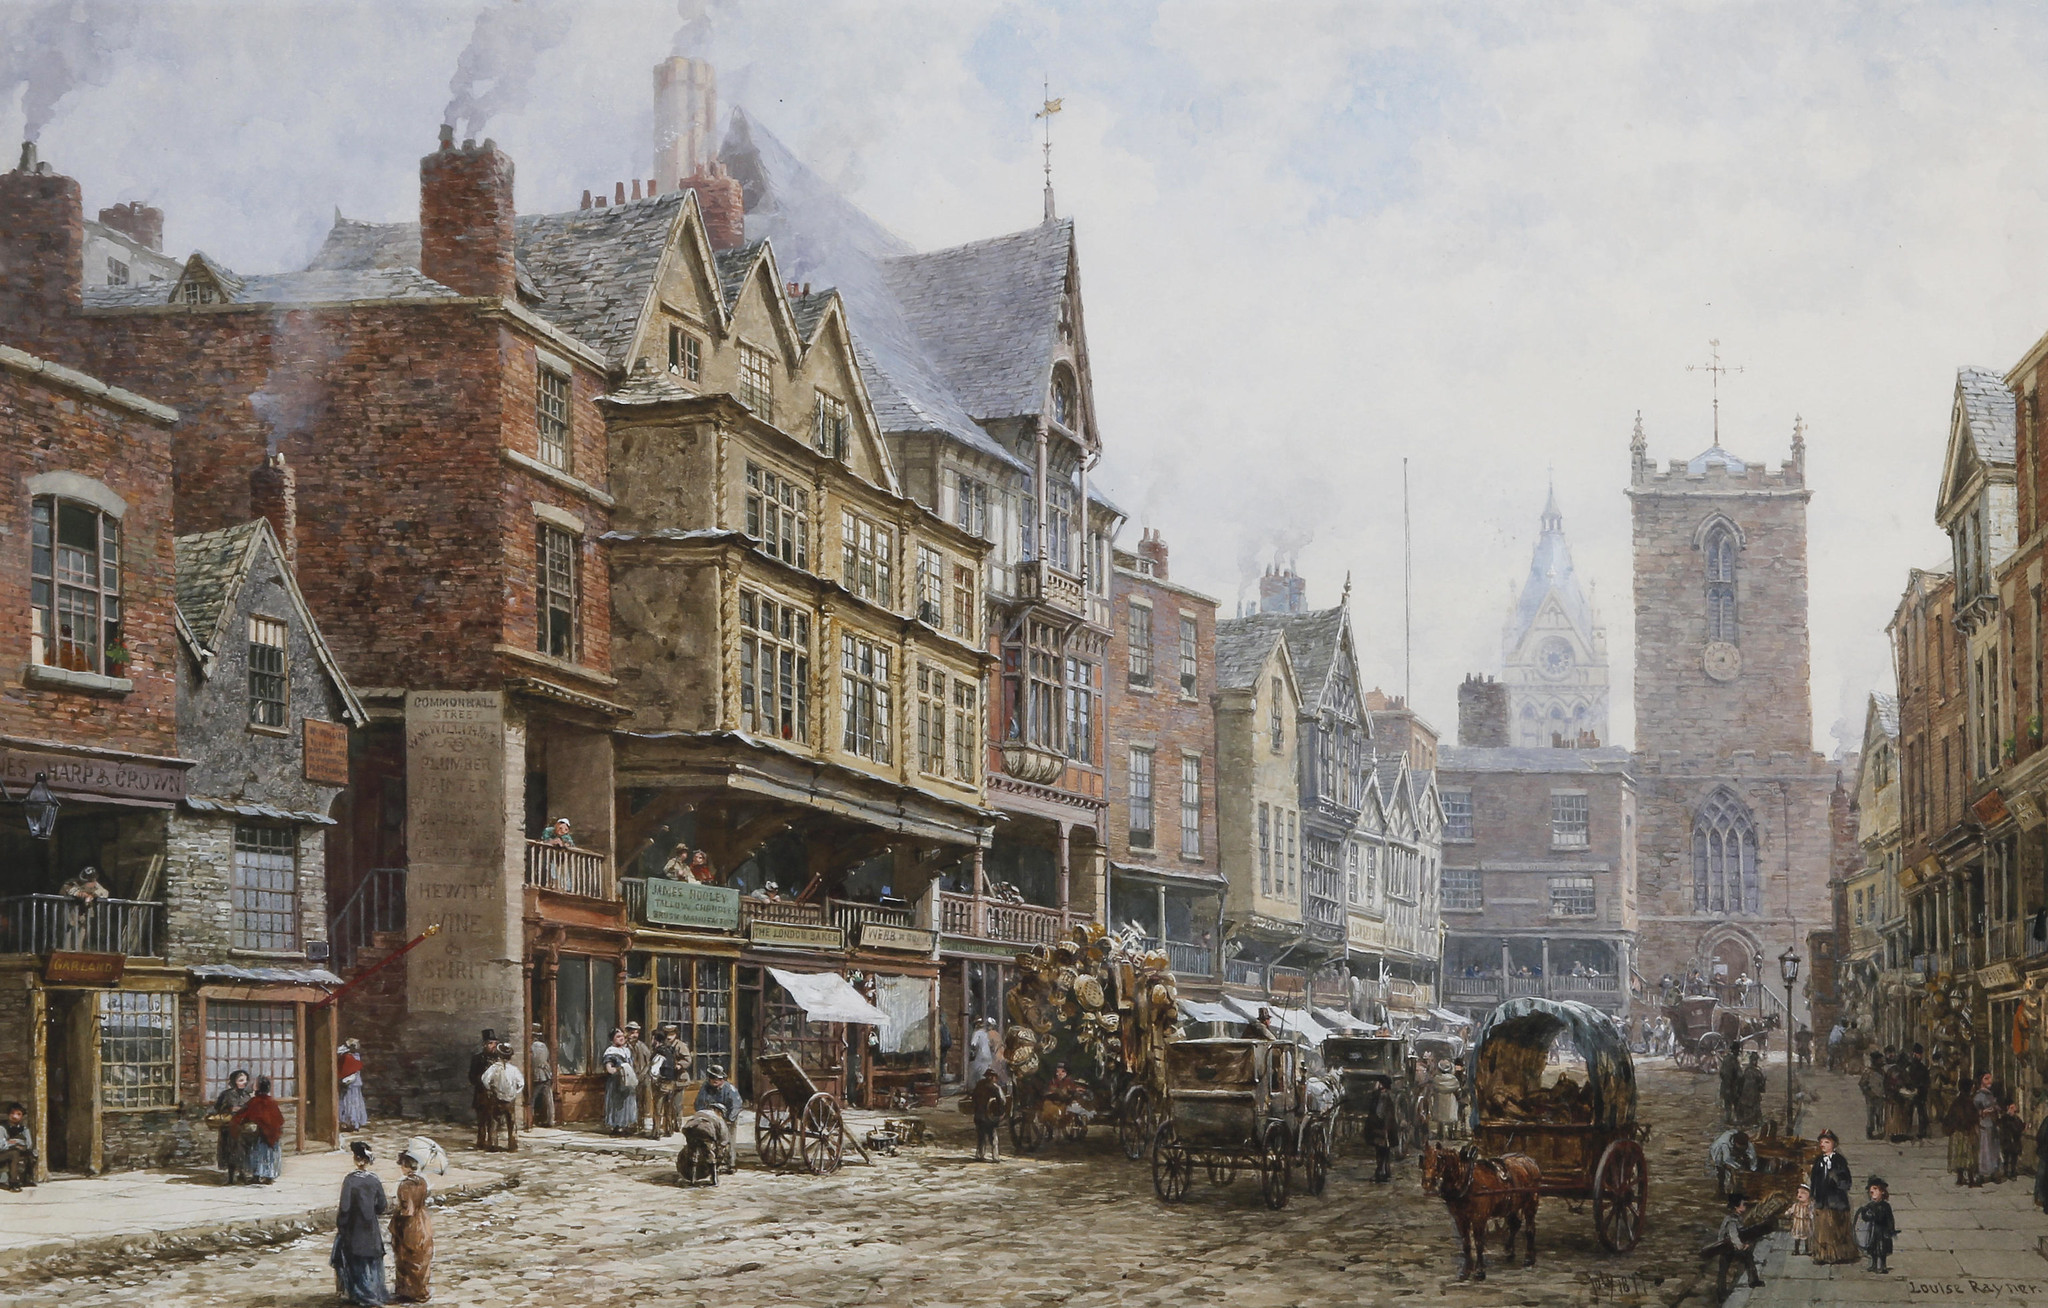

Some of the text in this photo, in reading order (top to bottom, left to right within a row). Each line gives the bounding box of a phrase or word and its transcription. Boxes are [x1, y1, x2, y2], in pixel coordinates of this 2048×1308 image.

[433, 709, 482, 719] STREET
[47, 760, 94, 785] HARP
[96, 768, 112, 788] &
[115, 768, 181, 794] CROWN
[651, 884, 684, 898] JAMES
[754, 927, 770, 938] THE
[773, 928, 807, 940] LONDON
[53, 958, 113, 973] GARLAND
[1909, 1281, 1964, 1295] Louise
